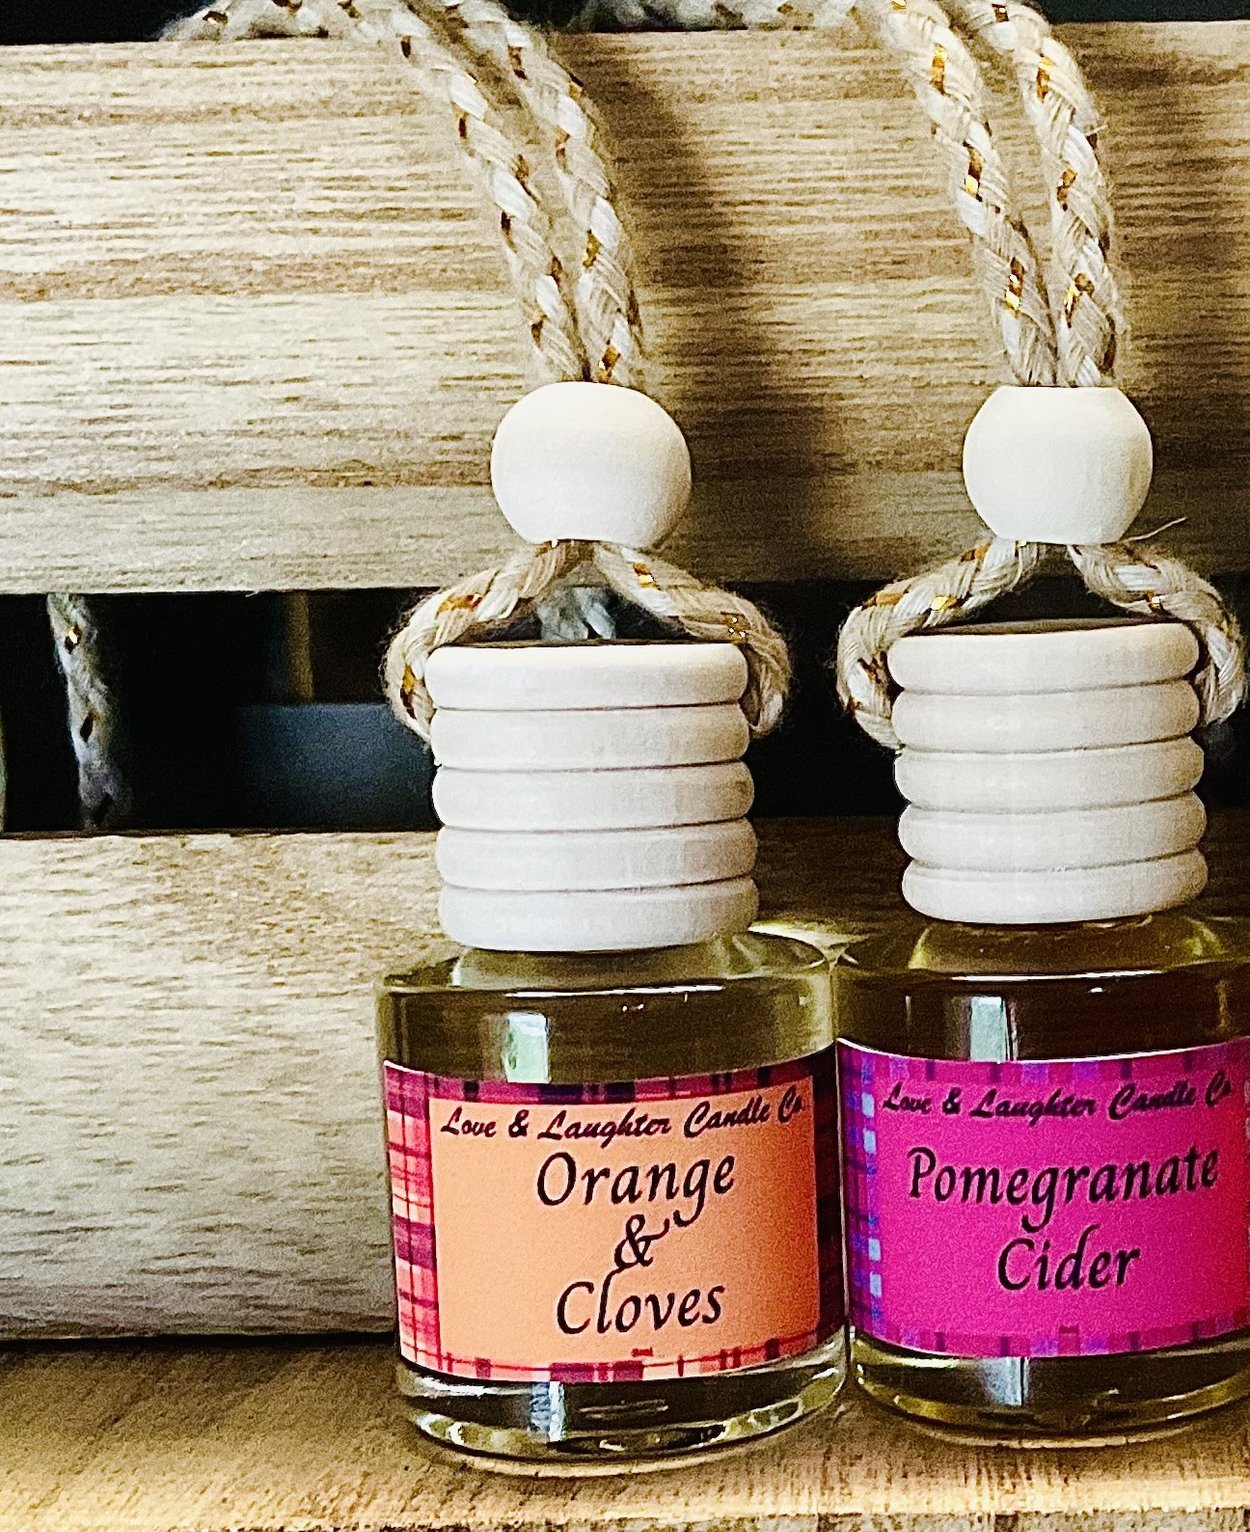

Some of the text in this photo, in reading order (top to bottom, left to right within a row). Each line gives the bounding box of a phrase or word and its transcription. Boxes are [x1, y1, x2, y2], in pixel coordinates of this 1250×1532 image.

[440, 1107, 497, 1136] Love
[508, 1110, 529, 1136] &
[538, 1108, 671, 1149] Laughter
[684, 1097, 770, 1138] Candle
[882, 1083, 932, 1114] Love
[942, 1087, 961, 1114] &
[971, 1088, 1097, 1126] Laughter
[1109, 1081, 1196, 1120] Candle
[536, 1151, 736, 1228] Orange
[907, 1145, 1219, 1233] Pomegranate
[614, 1214, 670, 1270] &
[998, 1224, 1141, 1290] Cider
[557, 1267, 726, 1335] Cloves
